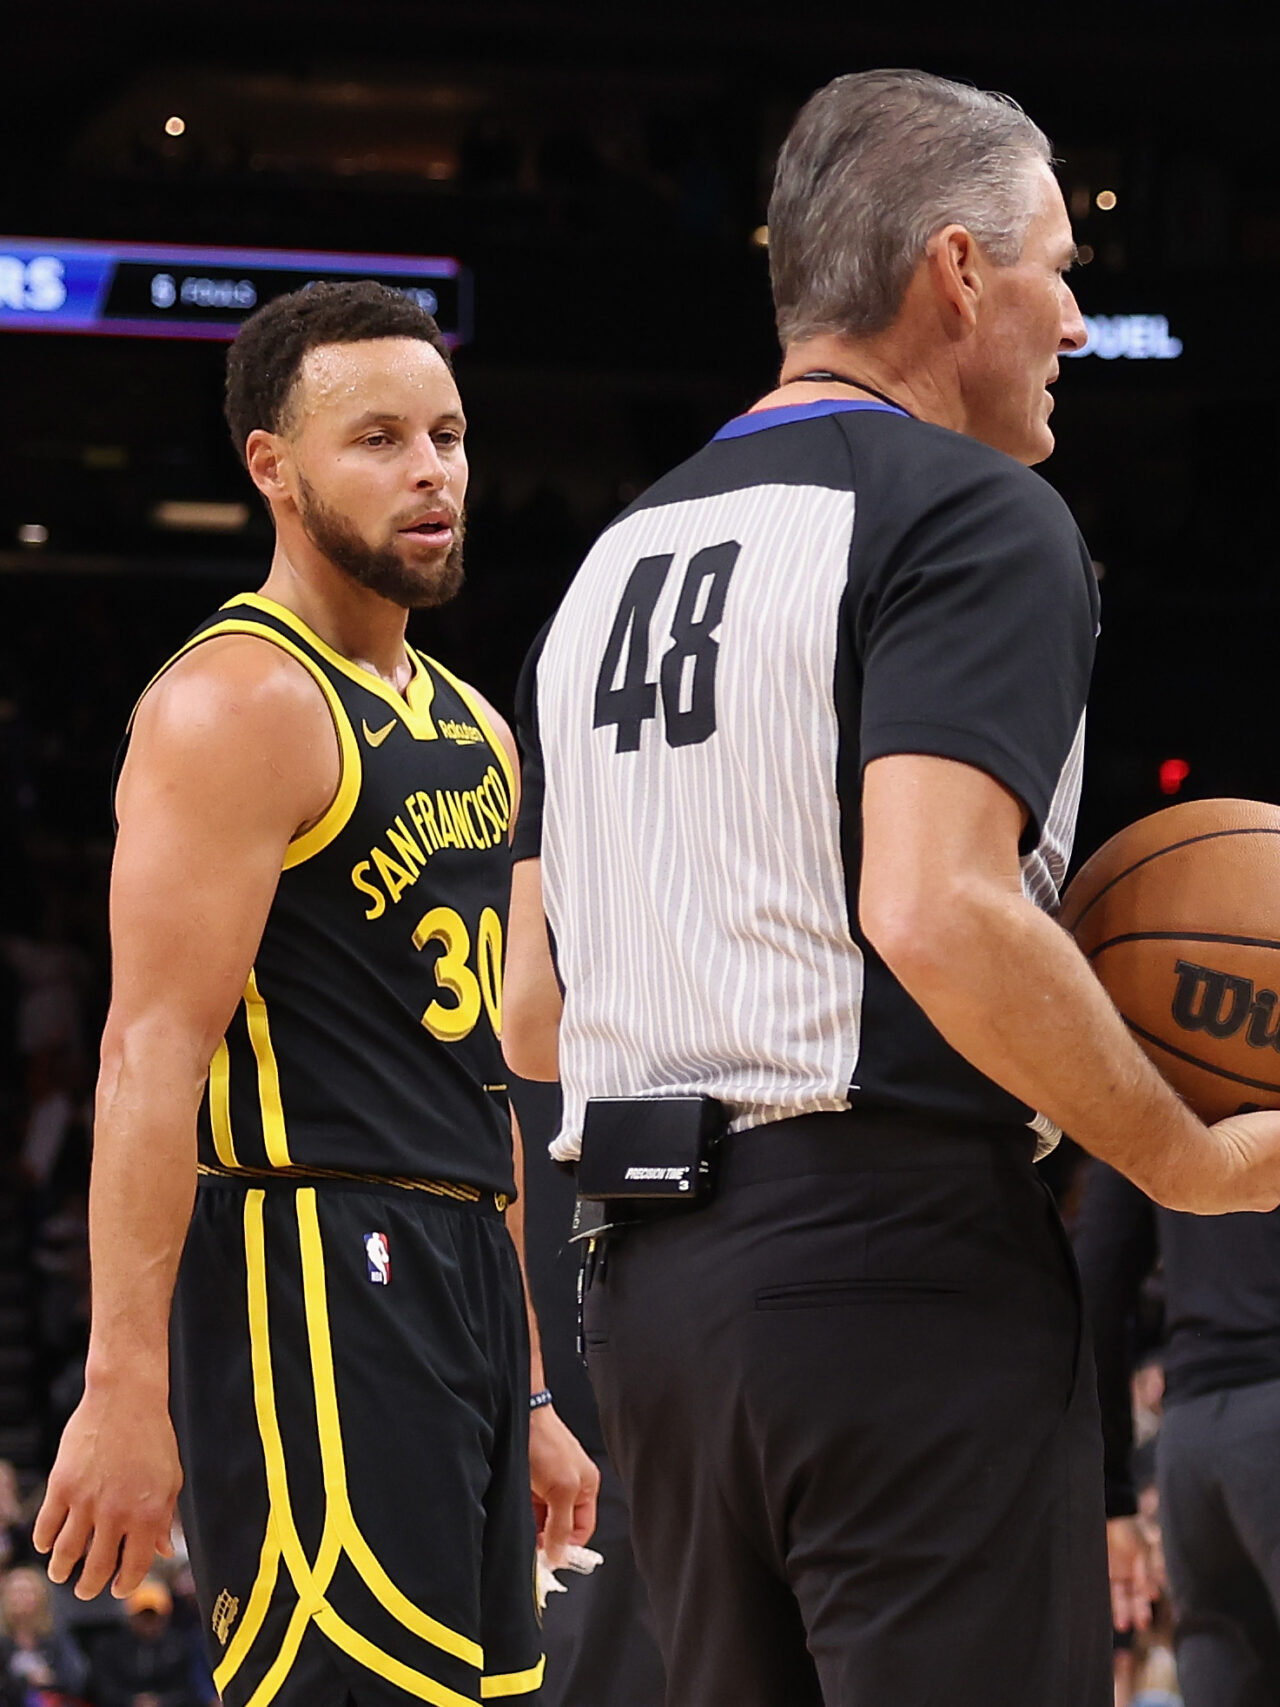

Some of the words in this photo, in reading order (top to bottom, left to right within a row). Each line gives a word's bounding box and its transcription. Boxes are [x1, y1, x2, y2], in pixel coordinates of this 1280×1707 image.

[593, 540, 742, 754] 48
[438, 719, 484, 743] Rakuten
[352, 815, 427, 920] SAN
[405, 765, 510, 856] FRANCISCO
[411, 907, 503, 1042] 30
